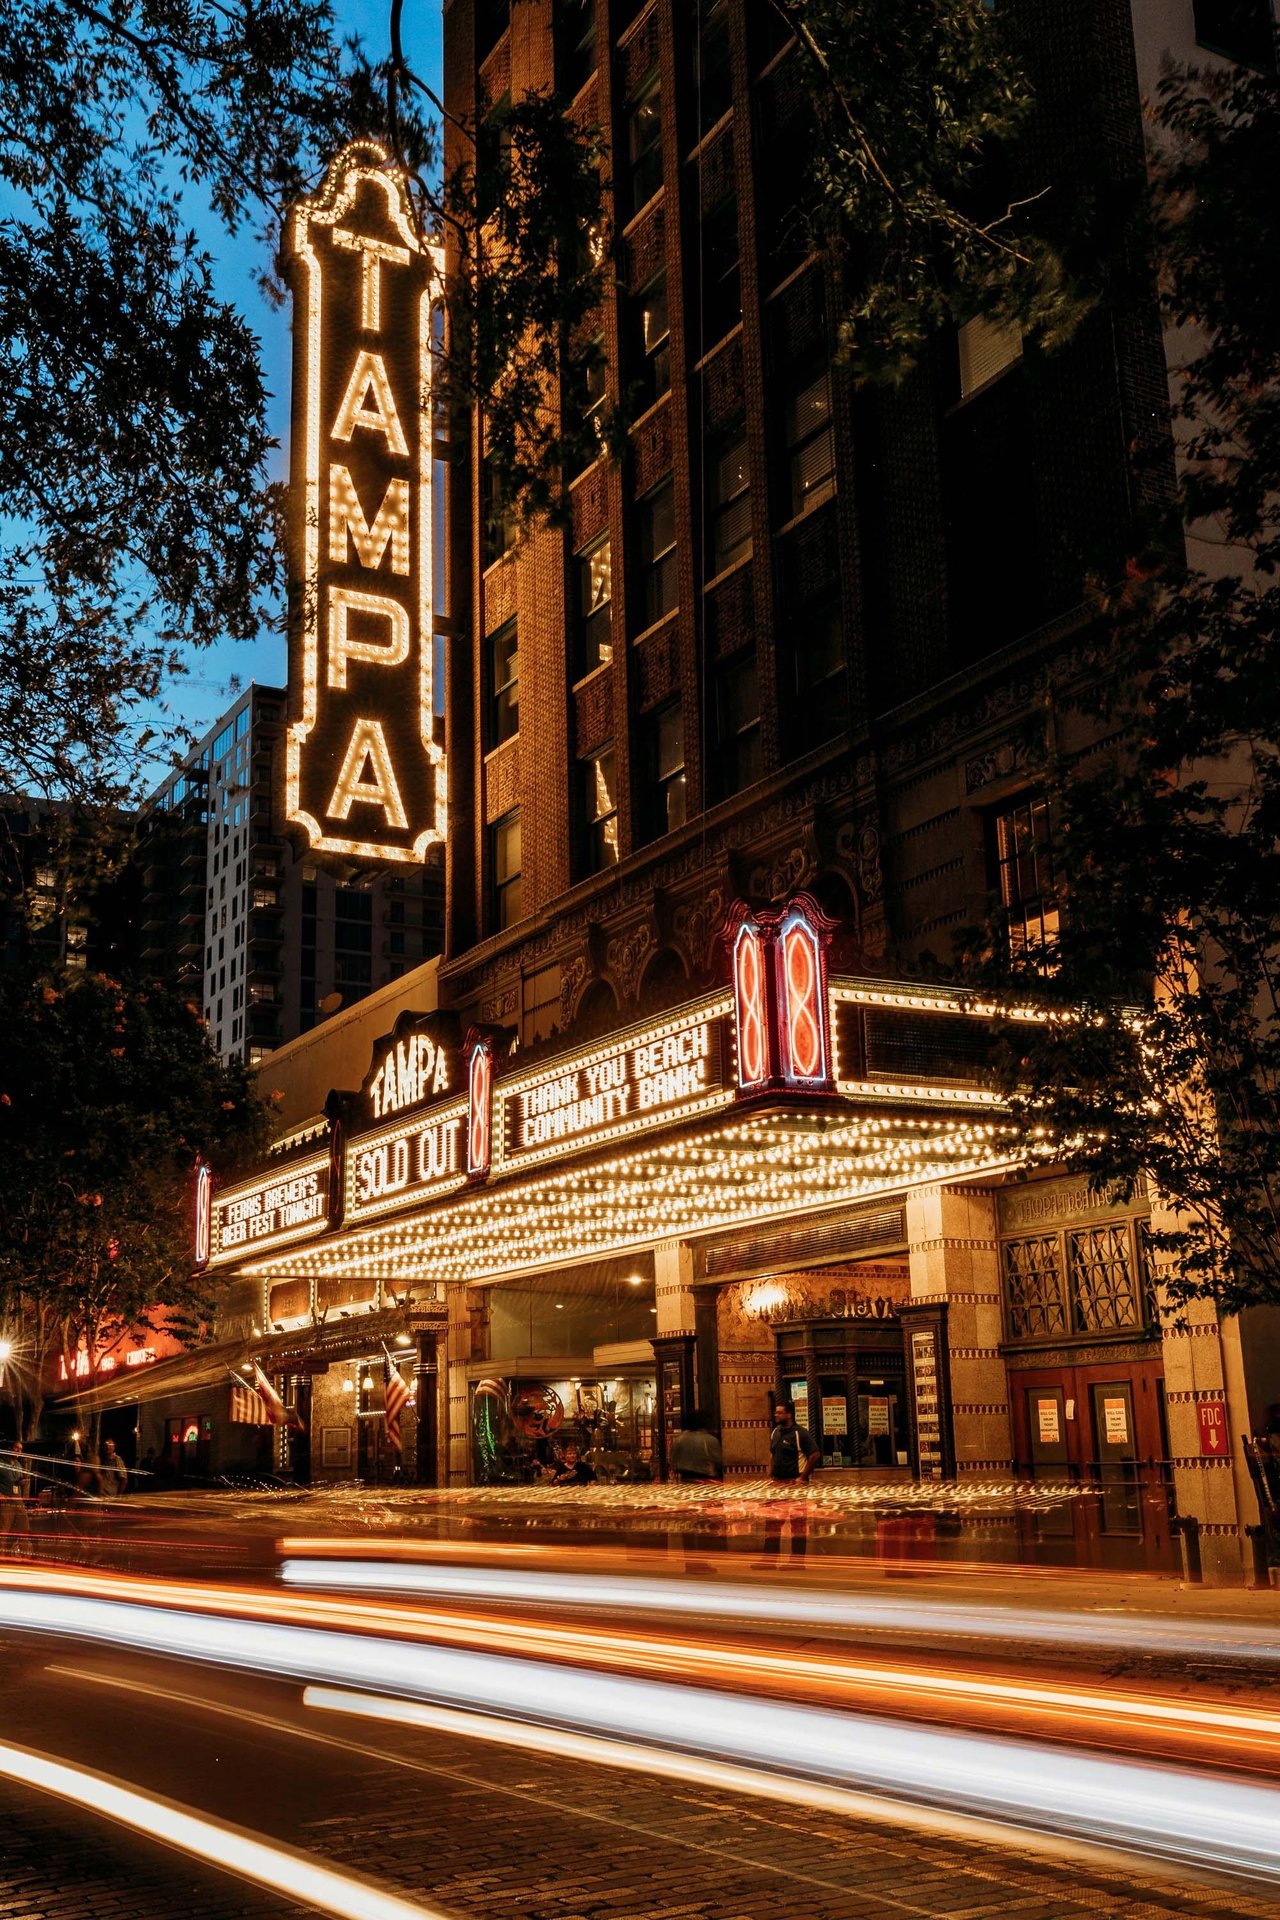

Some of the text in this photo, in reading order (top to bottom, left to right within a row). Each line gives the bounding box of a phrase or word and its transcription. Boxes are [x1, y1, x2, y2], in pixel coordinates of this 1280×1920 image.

[327, 227, 410, 830] TAMPA
[370, 1034, 449, 1119] TAMPA
[520, 1023, 708, 1119] THANK YOU BEACH
[523, 1058, 706, 1147] COMMUNITY BANK!
[228, 1172, 318, 1225] FERRIS BREWER'S
[360, 1118, 461, 1201] SOLD OUT
[222, 1192, 325, 1248] BEER FEST TONIGHT
[1201, 1407, 1222, 1426] FDC
